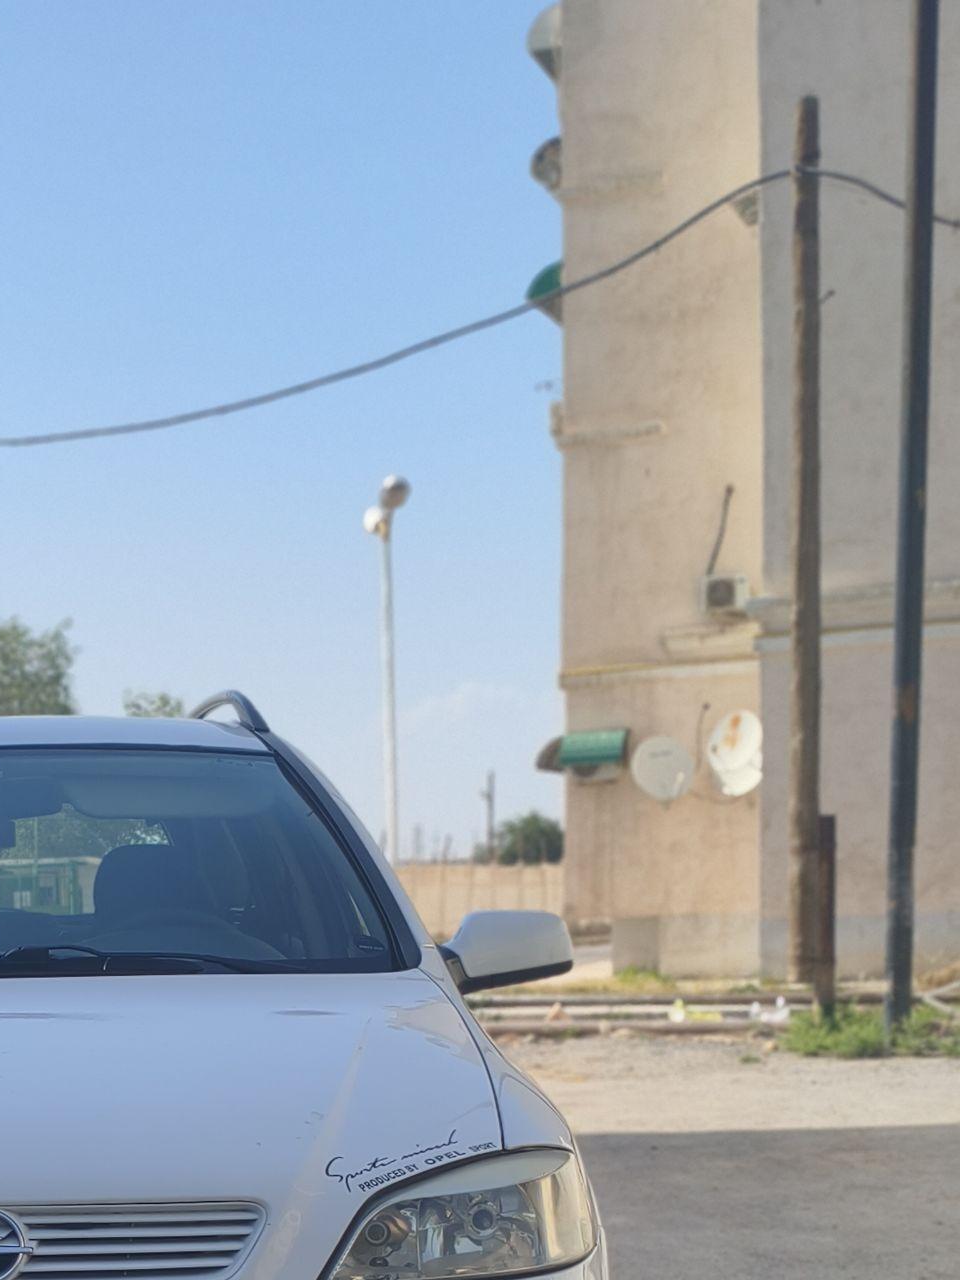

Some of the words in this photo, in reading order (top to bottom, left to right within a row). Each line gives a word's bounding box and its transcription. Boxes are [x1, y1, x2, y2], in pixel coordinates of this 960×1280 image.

[358, 1168, 404, 1192] PRODUCED
[405, 1163, 419, 1174] BY
[424, 1150, 467, 1166] OPEL
[468, 1142, 497, 1152] SPORT
